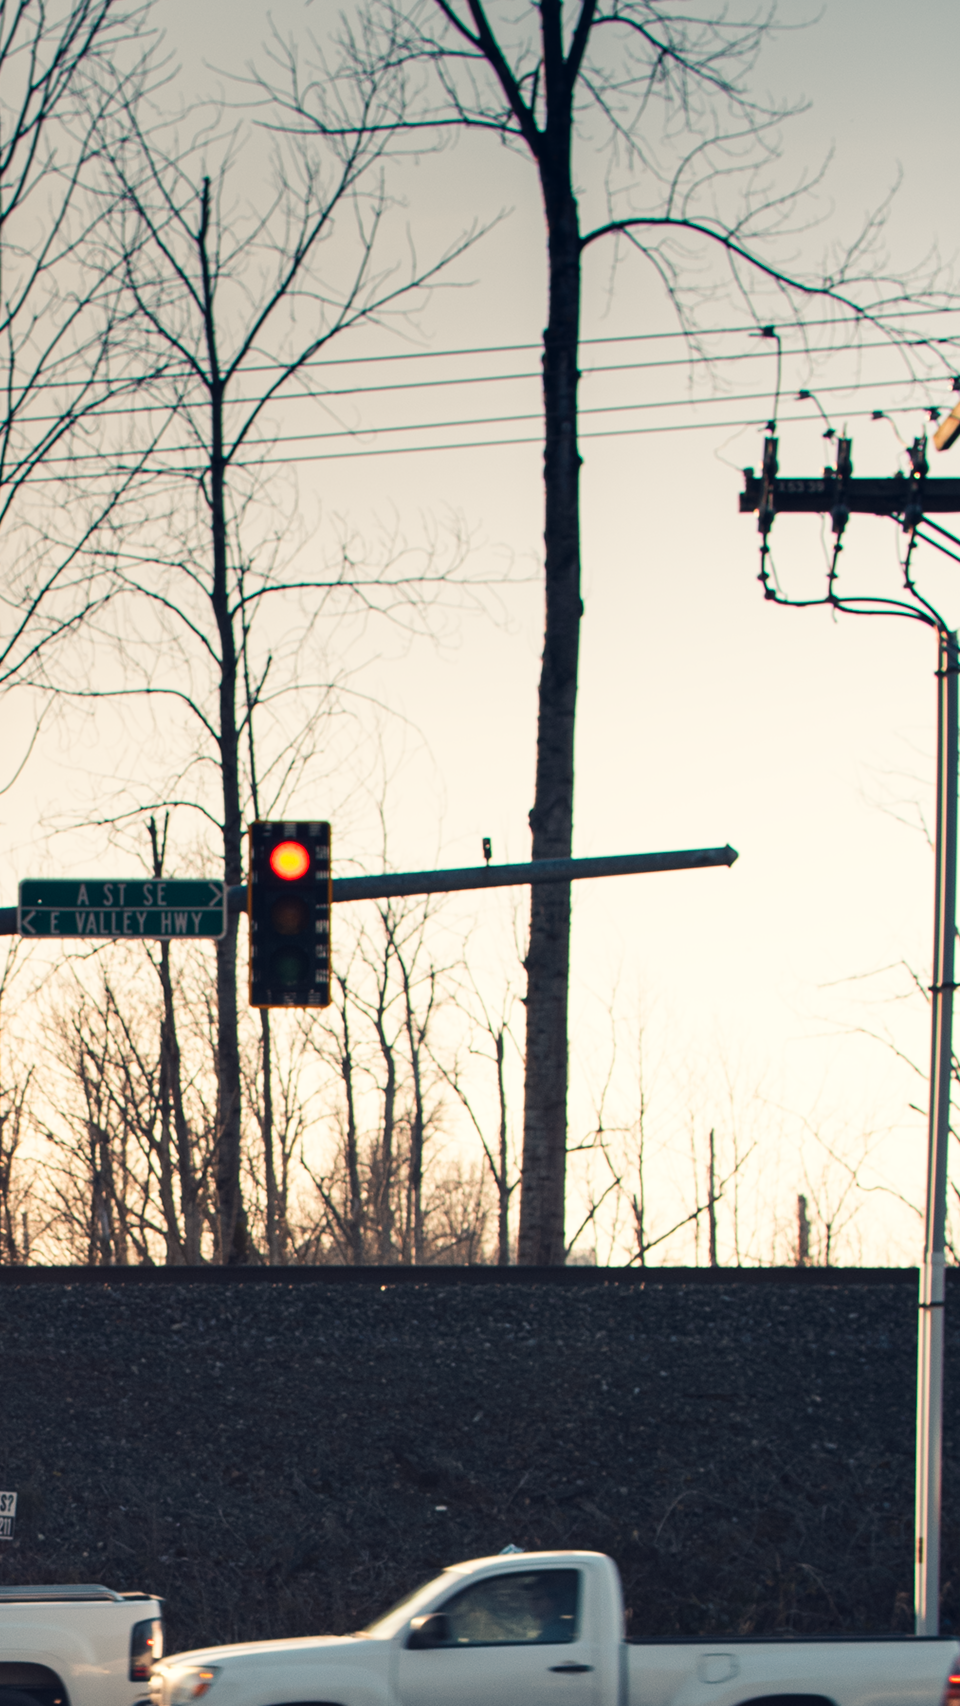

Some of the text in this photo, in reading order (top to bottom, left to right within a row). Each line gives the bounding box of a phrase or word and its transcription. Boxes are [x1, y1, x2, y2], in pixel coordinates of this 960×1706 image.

[77, 883, 167, 906] A ST SE
[50, 912, 203, 934] E VALLEY HWY
